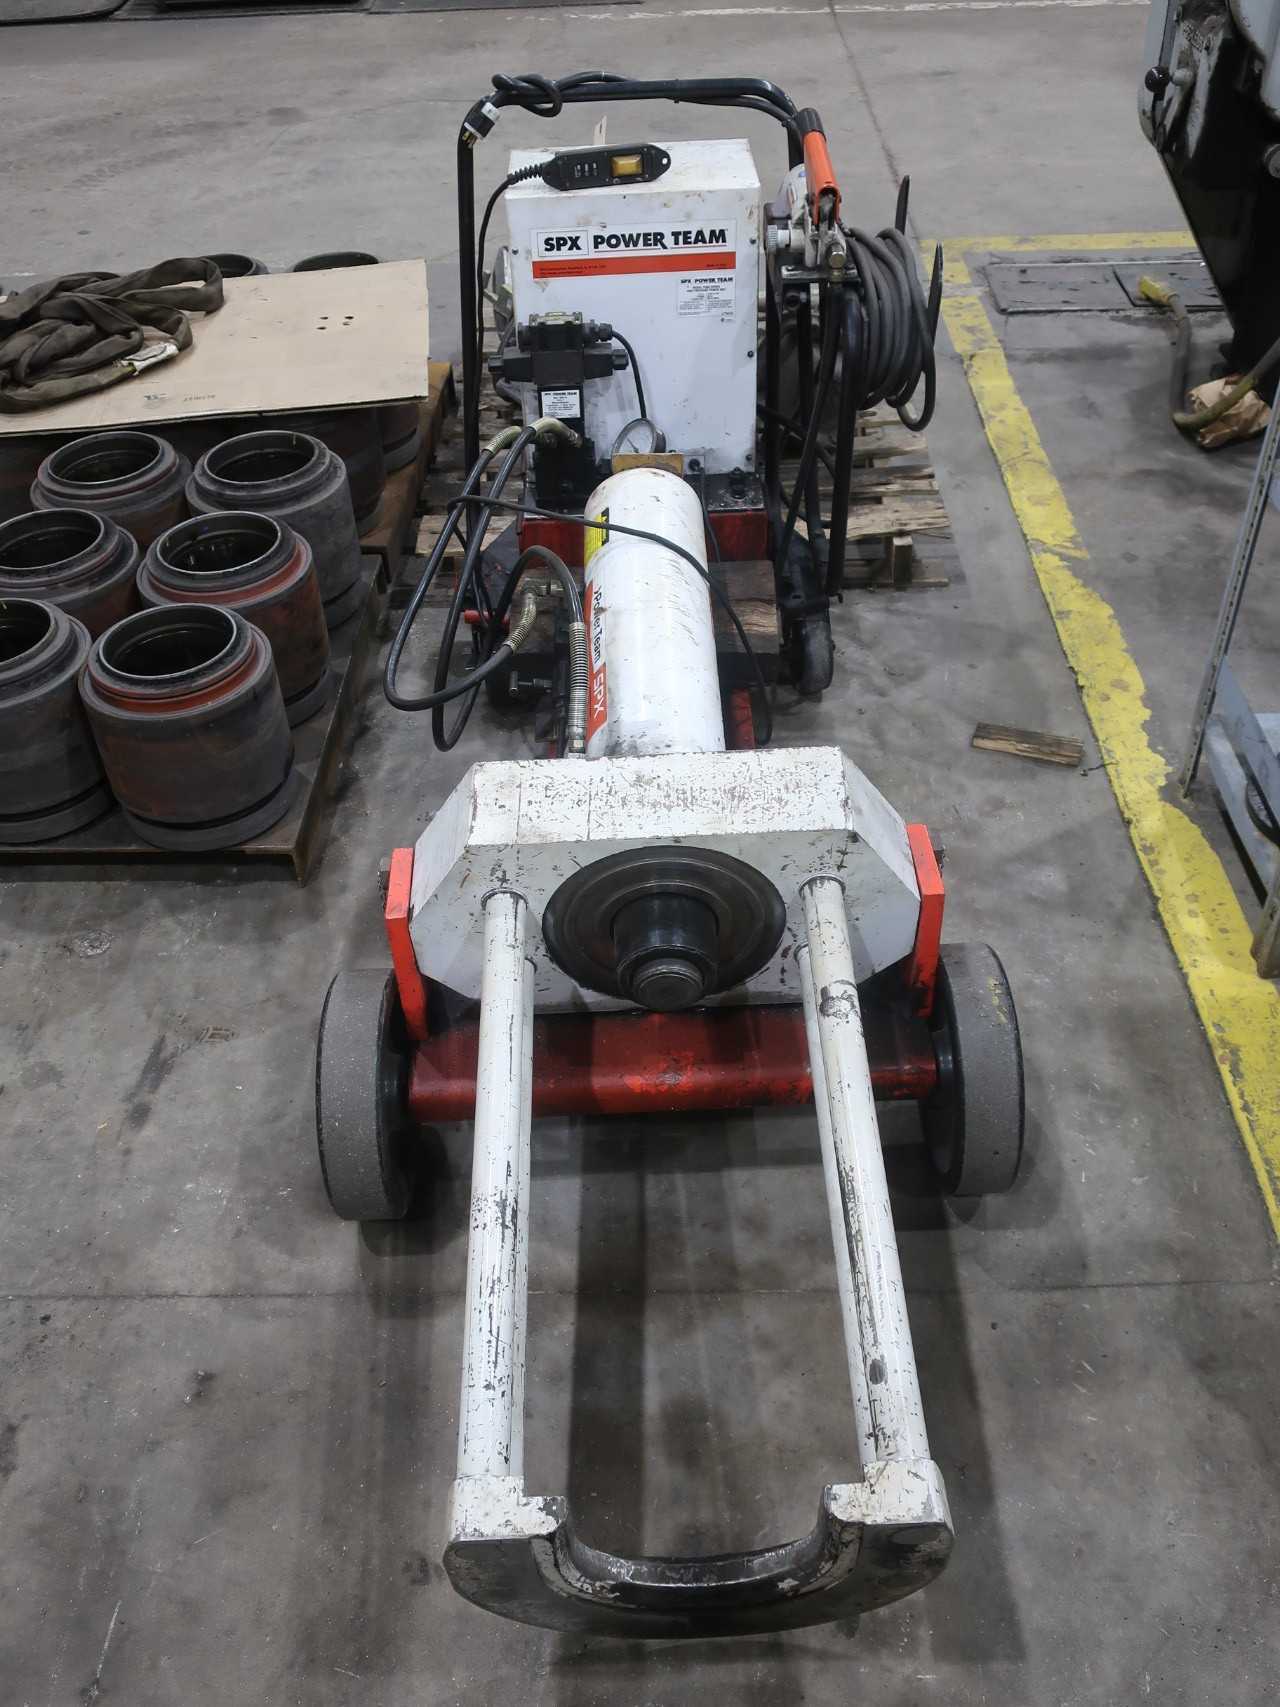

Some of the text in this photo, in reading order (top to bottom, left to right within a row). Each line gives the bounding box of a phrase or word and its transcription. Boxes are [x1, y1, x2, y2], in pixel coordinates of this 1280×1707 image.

[544, 228, 727, 252] SPX POWER TEAM
[593, 627, 603, 664] Team
[593, 672, 605, 719] SPX
